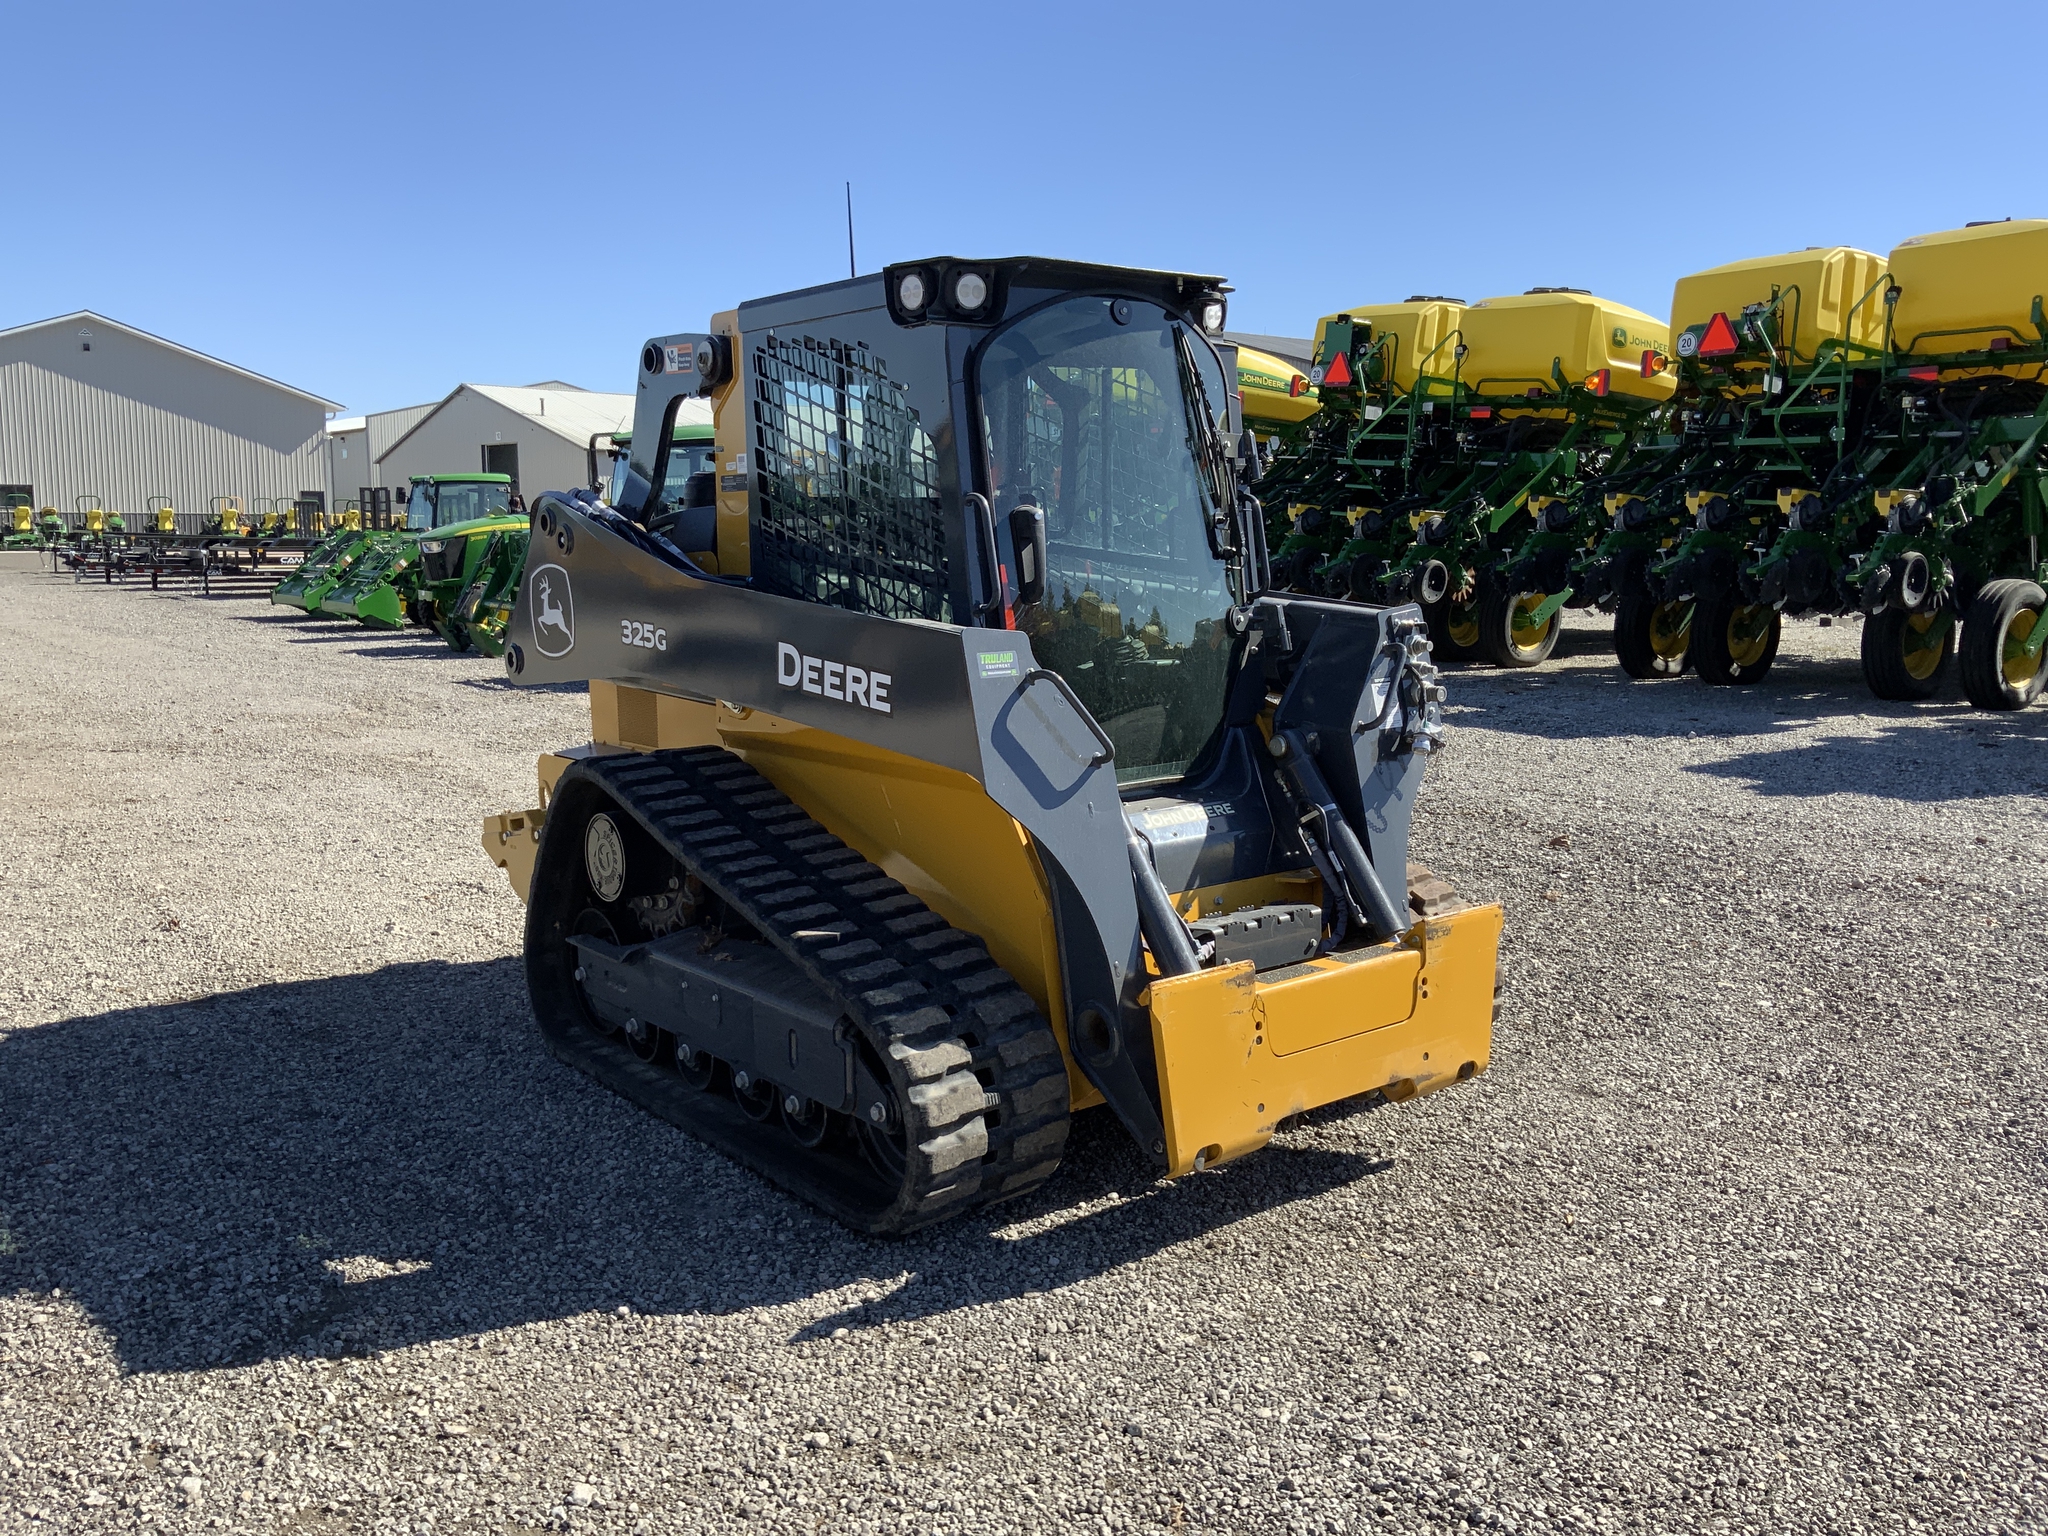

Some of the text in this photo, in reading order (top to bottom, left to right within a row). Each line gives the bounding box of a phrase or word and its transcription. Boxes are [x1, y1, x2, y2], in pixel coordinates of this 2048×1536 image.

[1629, 335, 1652, 349] JOHN
[1653, 341, 1670, 354] DEE
[1682, 338, 1692, 348] 20
[1242, 373, 1285, 388] JOHN DEERE
[1313, 370, 1320, 378] 20
[207, 568, 223, 576] CAM
[621, 619, 667, 651] 325G
[981, 653, 1013, 664] TRULAND
[778, 641, 892, 714] DEERE
[1142, 803, 1235, 829] JOHN DEERE
